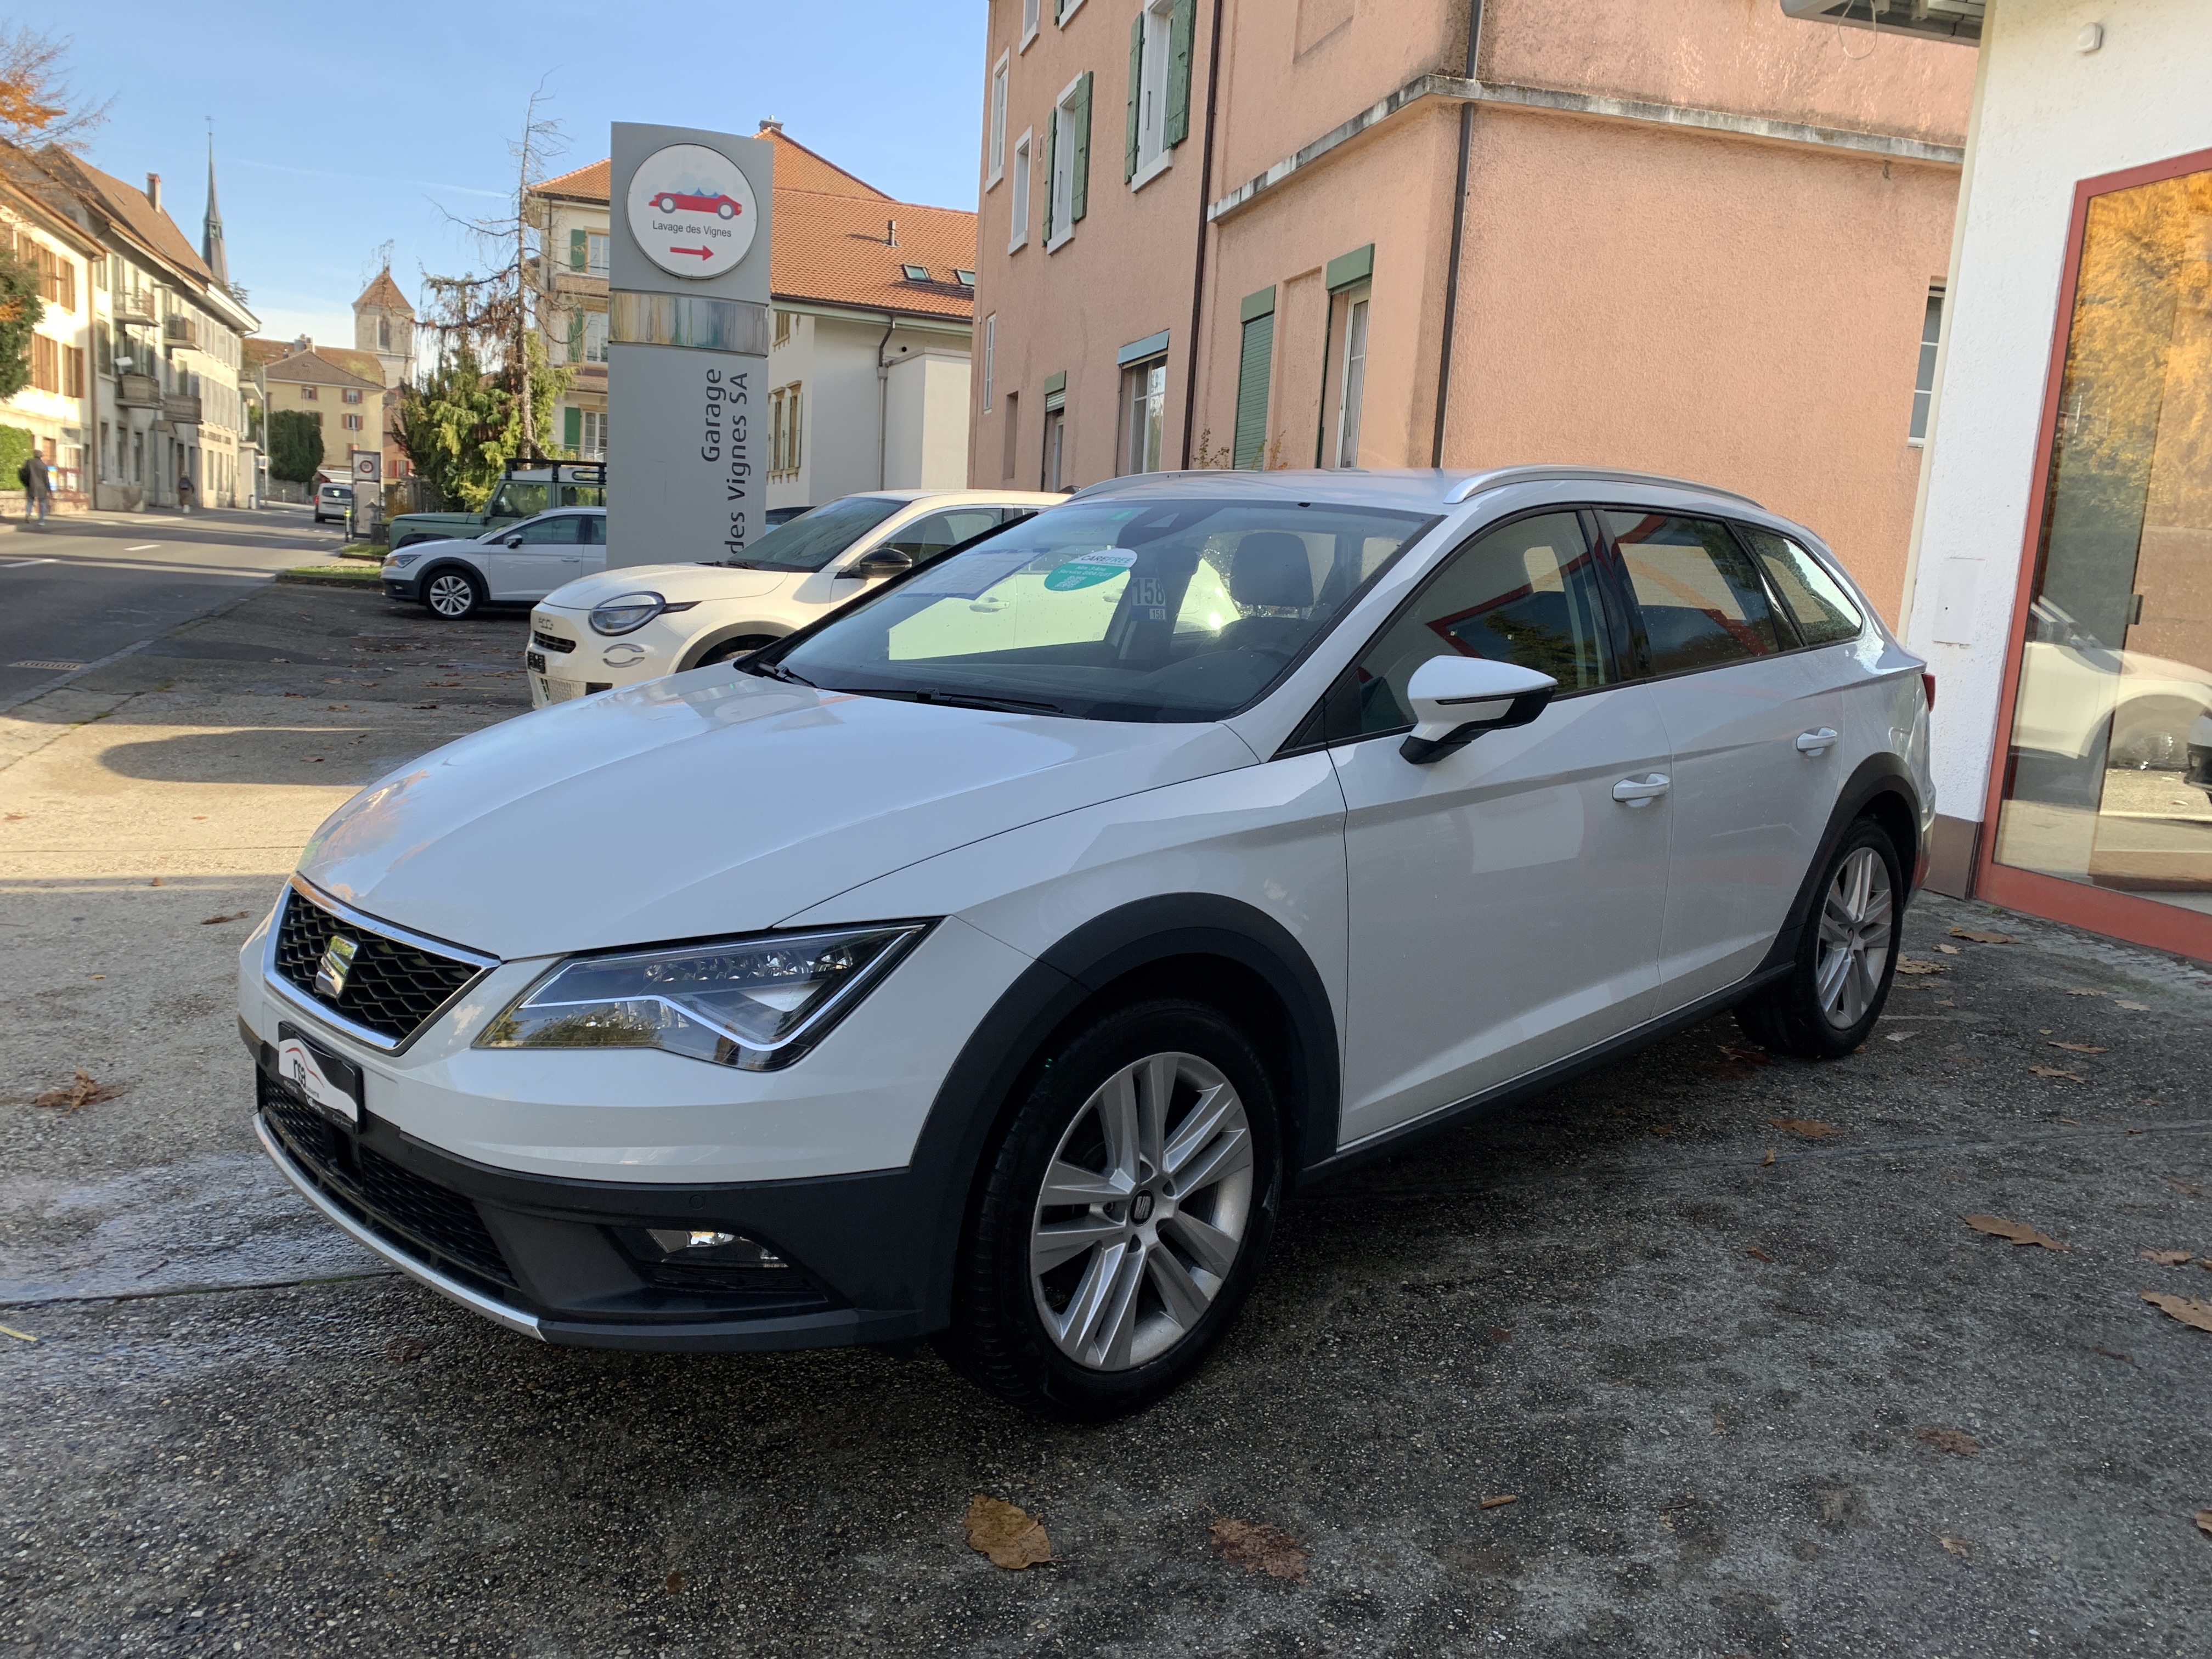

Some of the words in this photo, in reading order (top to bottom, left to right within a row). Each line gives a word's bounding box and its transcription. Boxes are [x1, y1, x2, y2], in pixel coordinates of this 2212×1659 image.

[653, 220, 684, 234] Lavage
[686, 224, 701, 234] des
[703, 225, 732, 238] Vignes
[730, 373, 748, 405] SA
[701, 368, 726, 462] Garage
[726, 415, 751, 501] Vignes
[724, 511, 745, 554] des
[1081, 555, 1134, 563] CAREFREE
[1133, 578, 1164, 605] 158
[1153, 610, 1163, 619] 158
